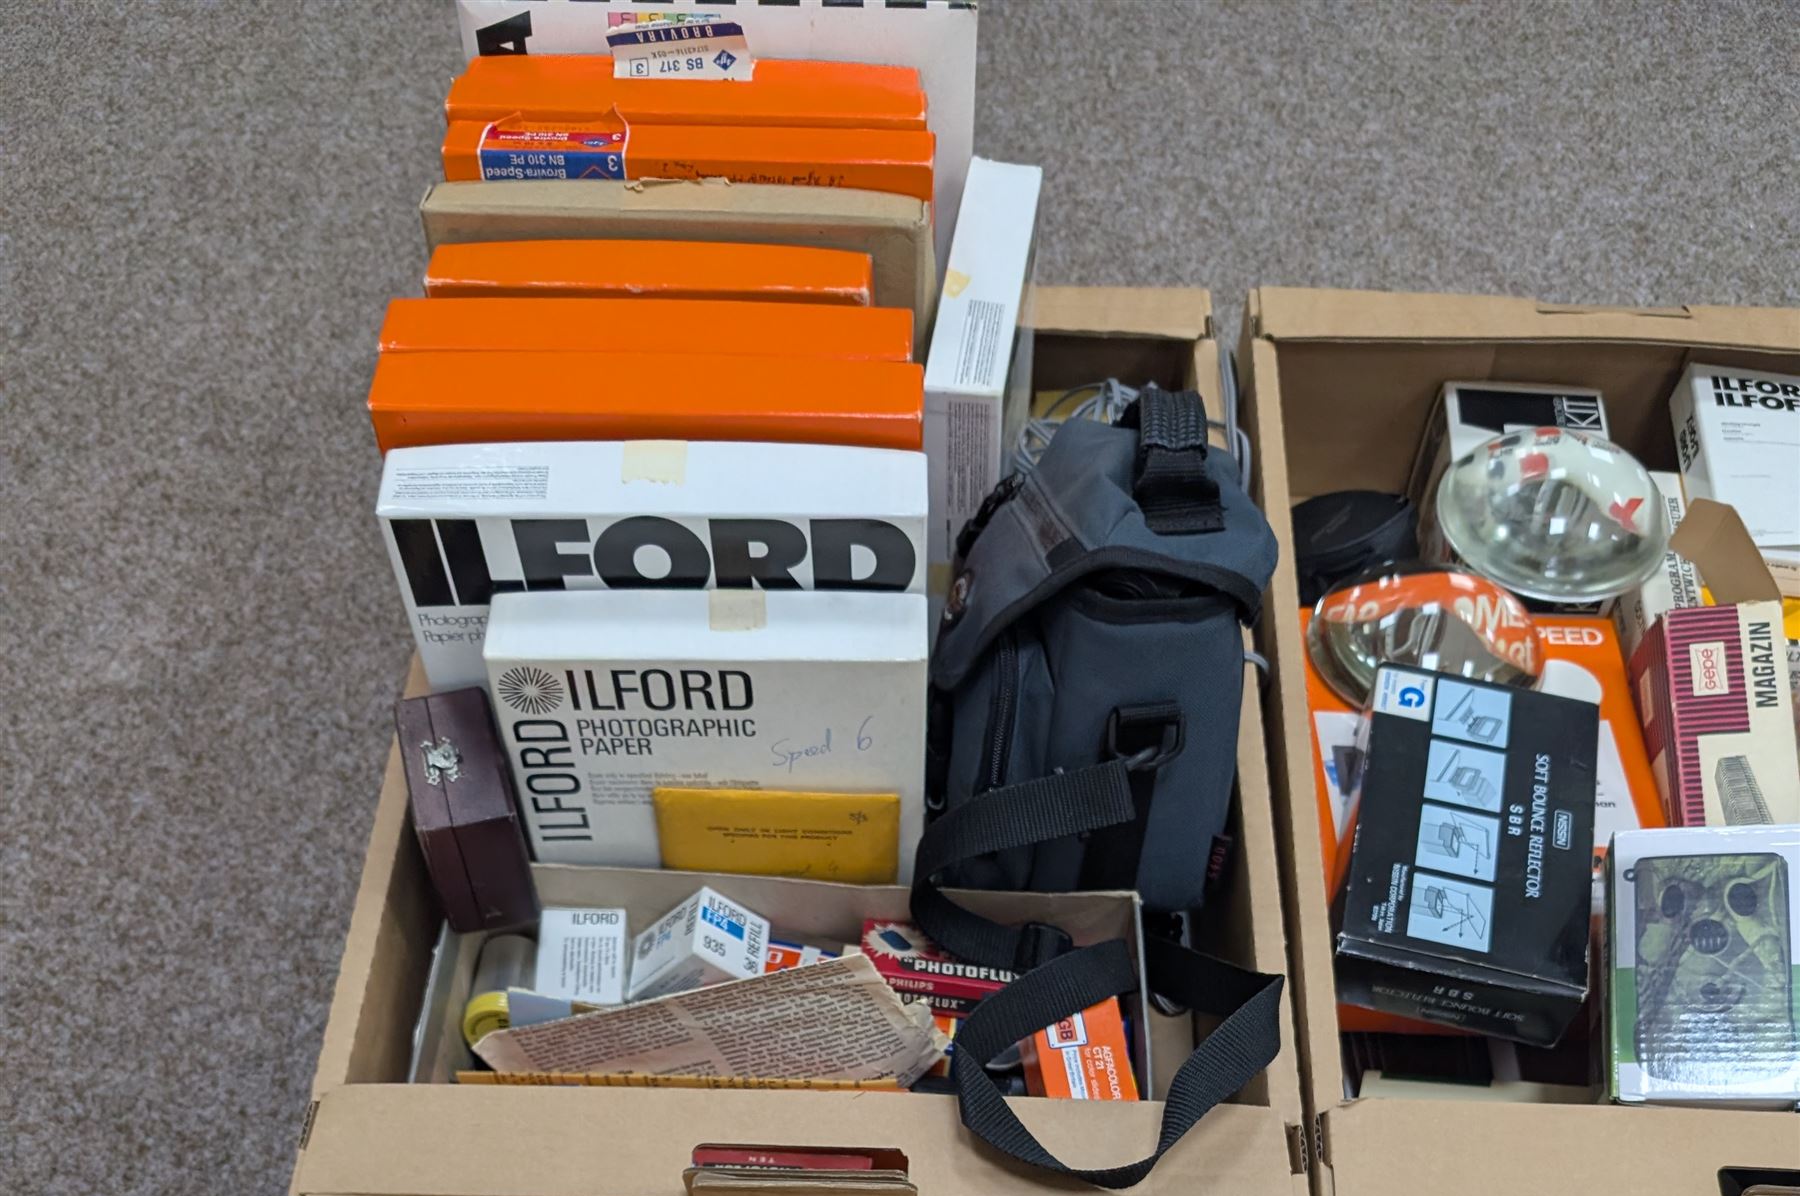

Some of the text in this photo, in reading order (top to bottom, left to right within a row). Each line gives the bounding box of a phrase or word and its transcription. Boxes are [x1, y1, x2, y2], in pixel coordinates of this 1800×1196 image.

[635, 25, 714, 44] BROVIRA
[635, 57, 704, 74] BS 317 3
[510, 155, 565, 165] BN 310 PE
[607, 155, 618, 171] 3
[388, 515, 916, 607] ILFORD
[418, 613, 489, 628] Photograp
[423, 630, 465, 645] Papier
[1748, 621, 1779, 709] MAGAZIN
[565, 668, 755, 712] ILFORD
[1398, 686, 1424, 708] G
[576, 718, 757, 738] PHOTOGRAPHIC
[580, 737, 653, 756] PAPER
[772, 715, 873, 773] Speed 6
[512, 719, 593, 842] ILFORD
[1525, 753, 1550, 899] SOFT BOUNCE REFLECTOR
[572, 912, 619, 926] ILFORD
[709, 895, 747, 927] ILFORD
[703, 935, 727, 957] 935
[889, 977, 935, 991] PHILIPS
